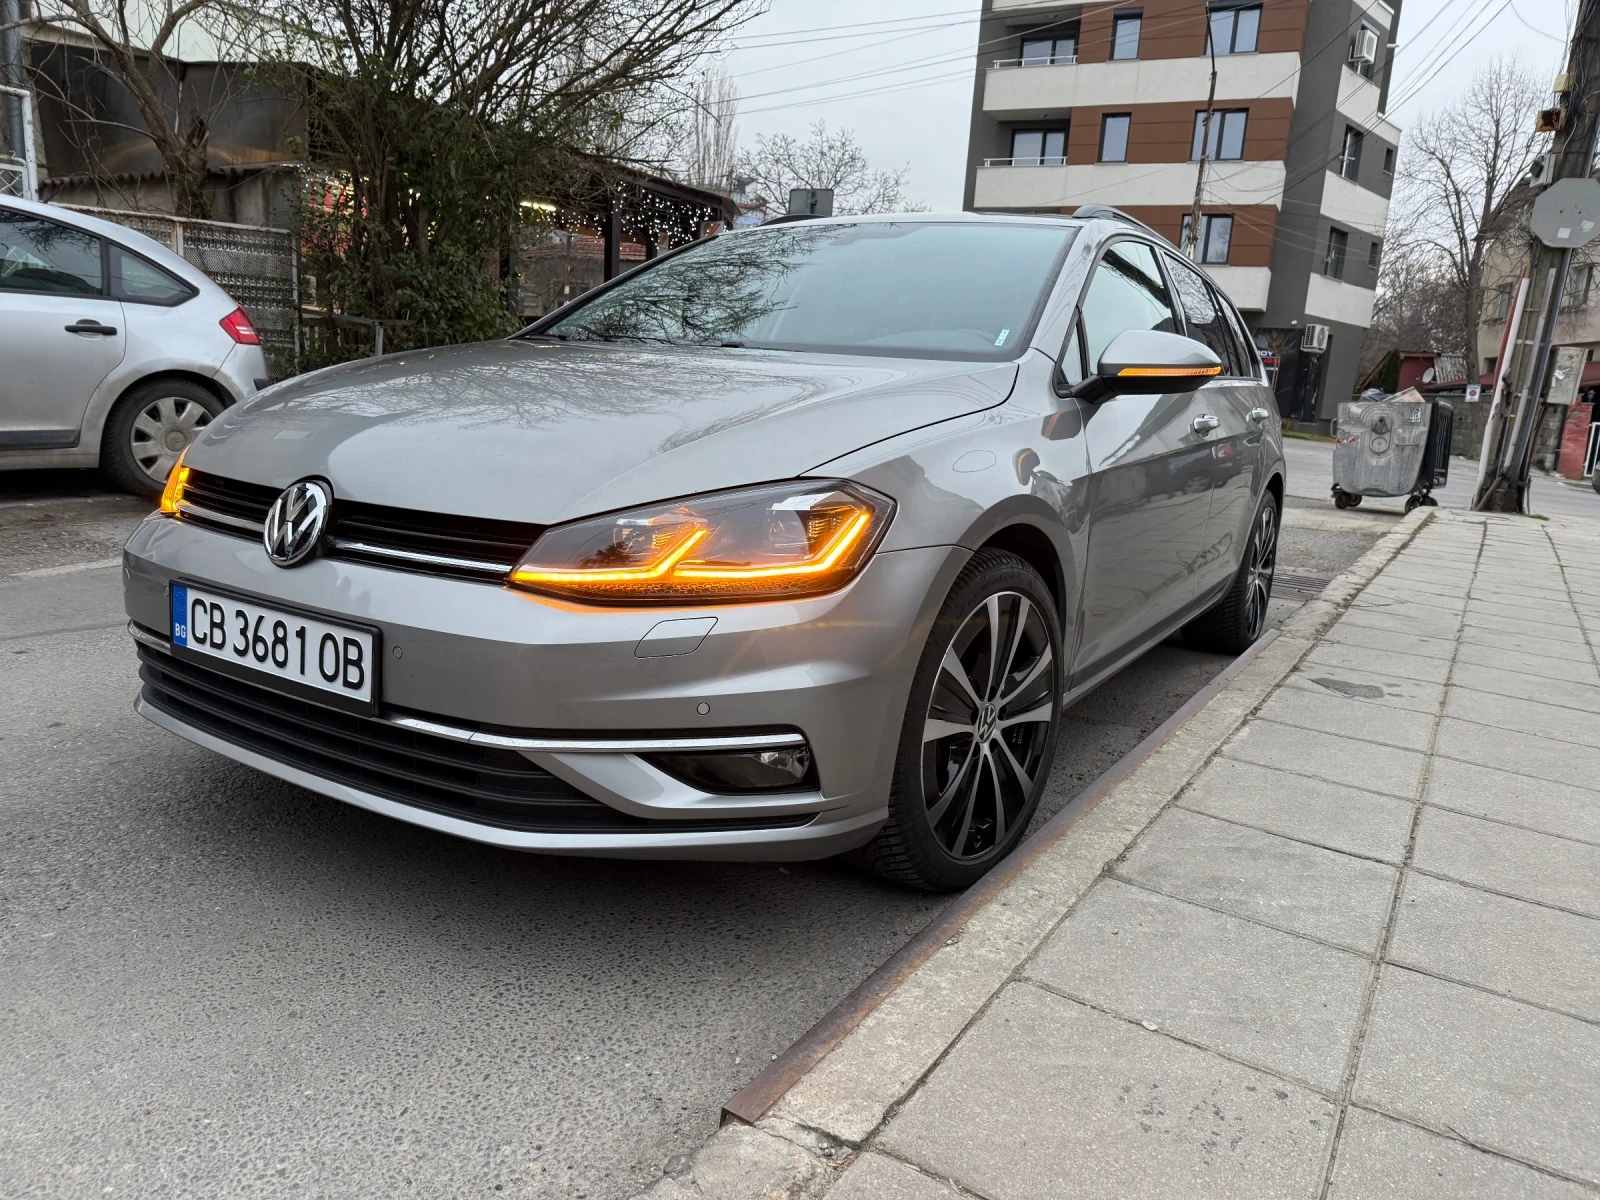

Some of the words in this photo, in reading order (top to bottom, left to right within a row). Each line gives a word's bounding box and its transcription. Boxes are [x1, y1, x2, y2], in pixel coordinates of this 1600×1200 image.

[174, 623, 187, 638] BG
[191, 598, 226, 650] CB
[233, 609, 306, 676] 3681
[319, 632, 365, 690] OB
